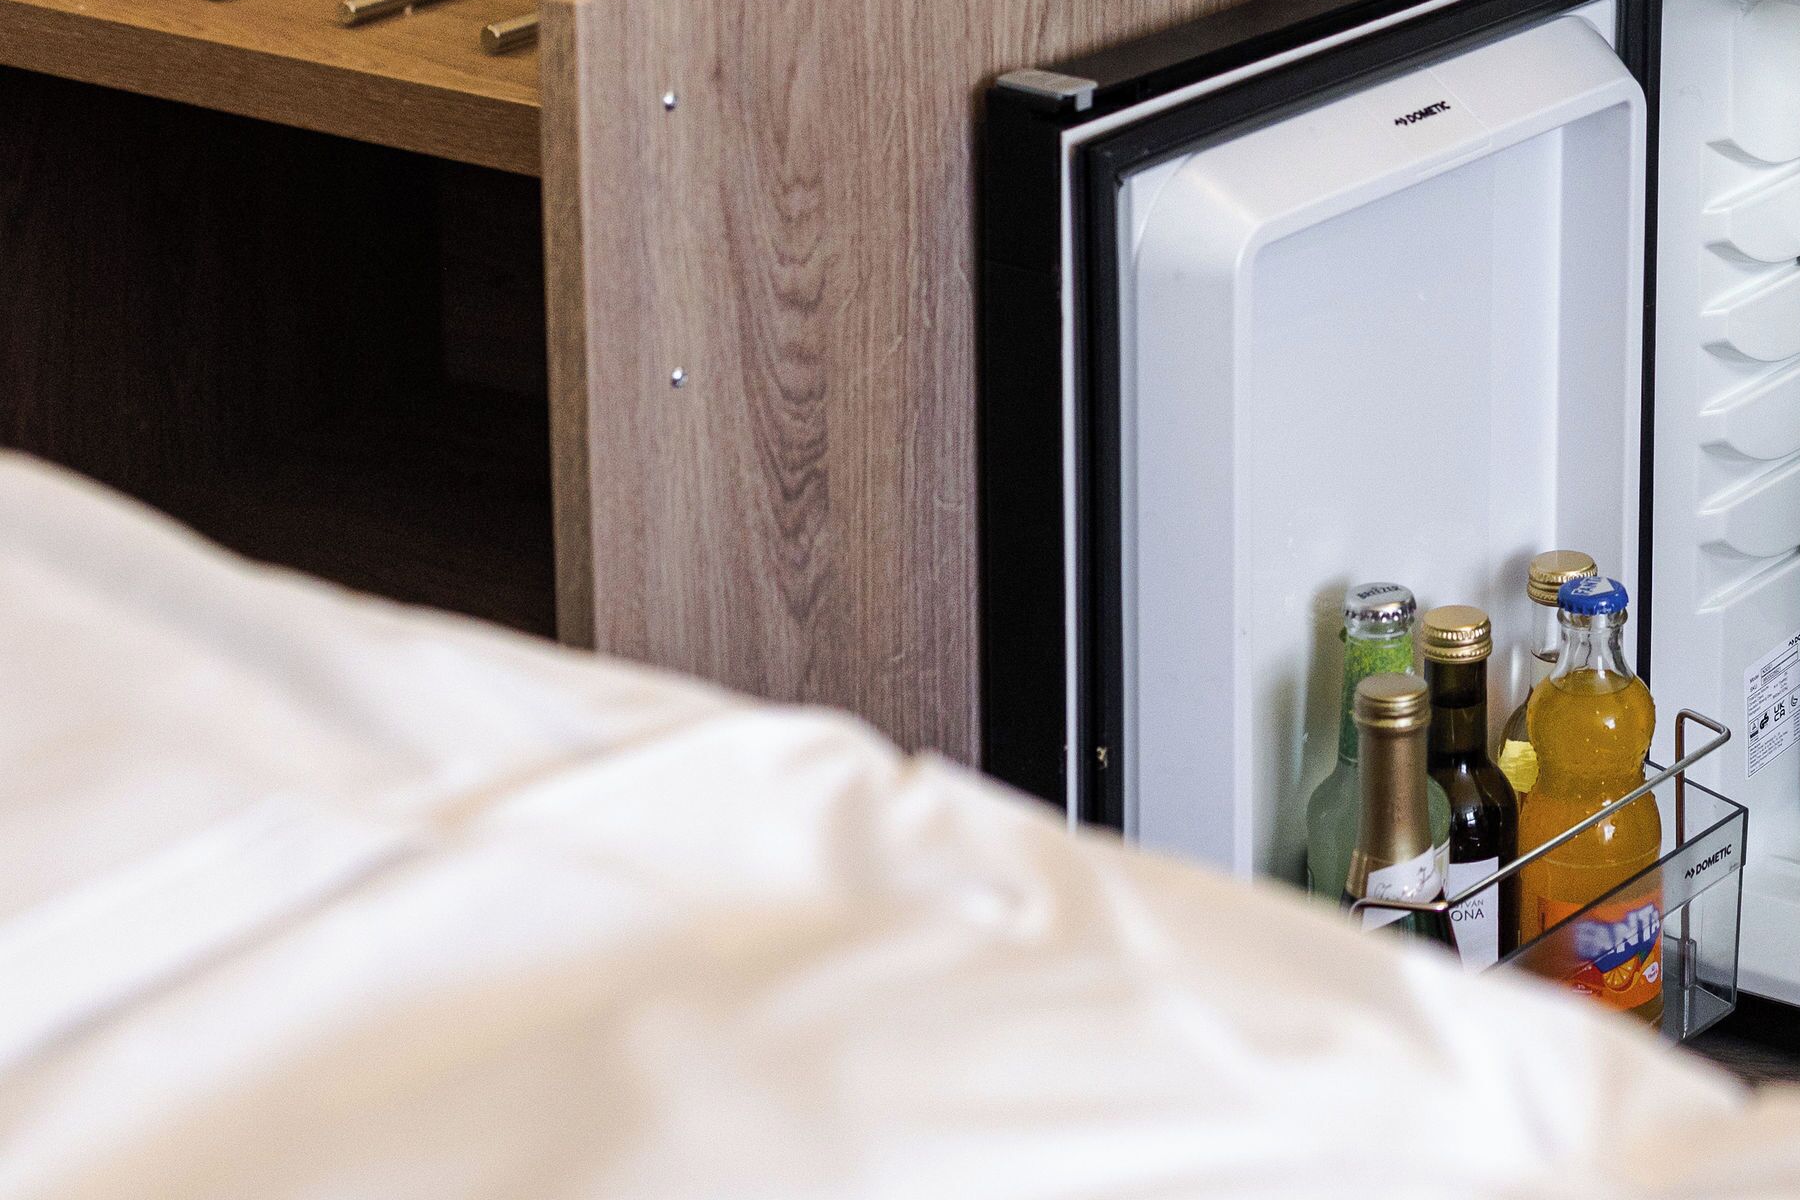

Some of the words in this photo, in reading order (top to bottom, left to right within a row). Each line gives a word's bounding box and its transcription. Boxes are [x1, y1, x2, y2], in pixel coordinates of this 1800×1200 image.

[1406, 101, 1451, 124] DOMETIC
[1695, 843, 1732, 876] DOMETIC
[1571, 901, 1660, 959] ANTA
